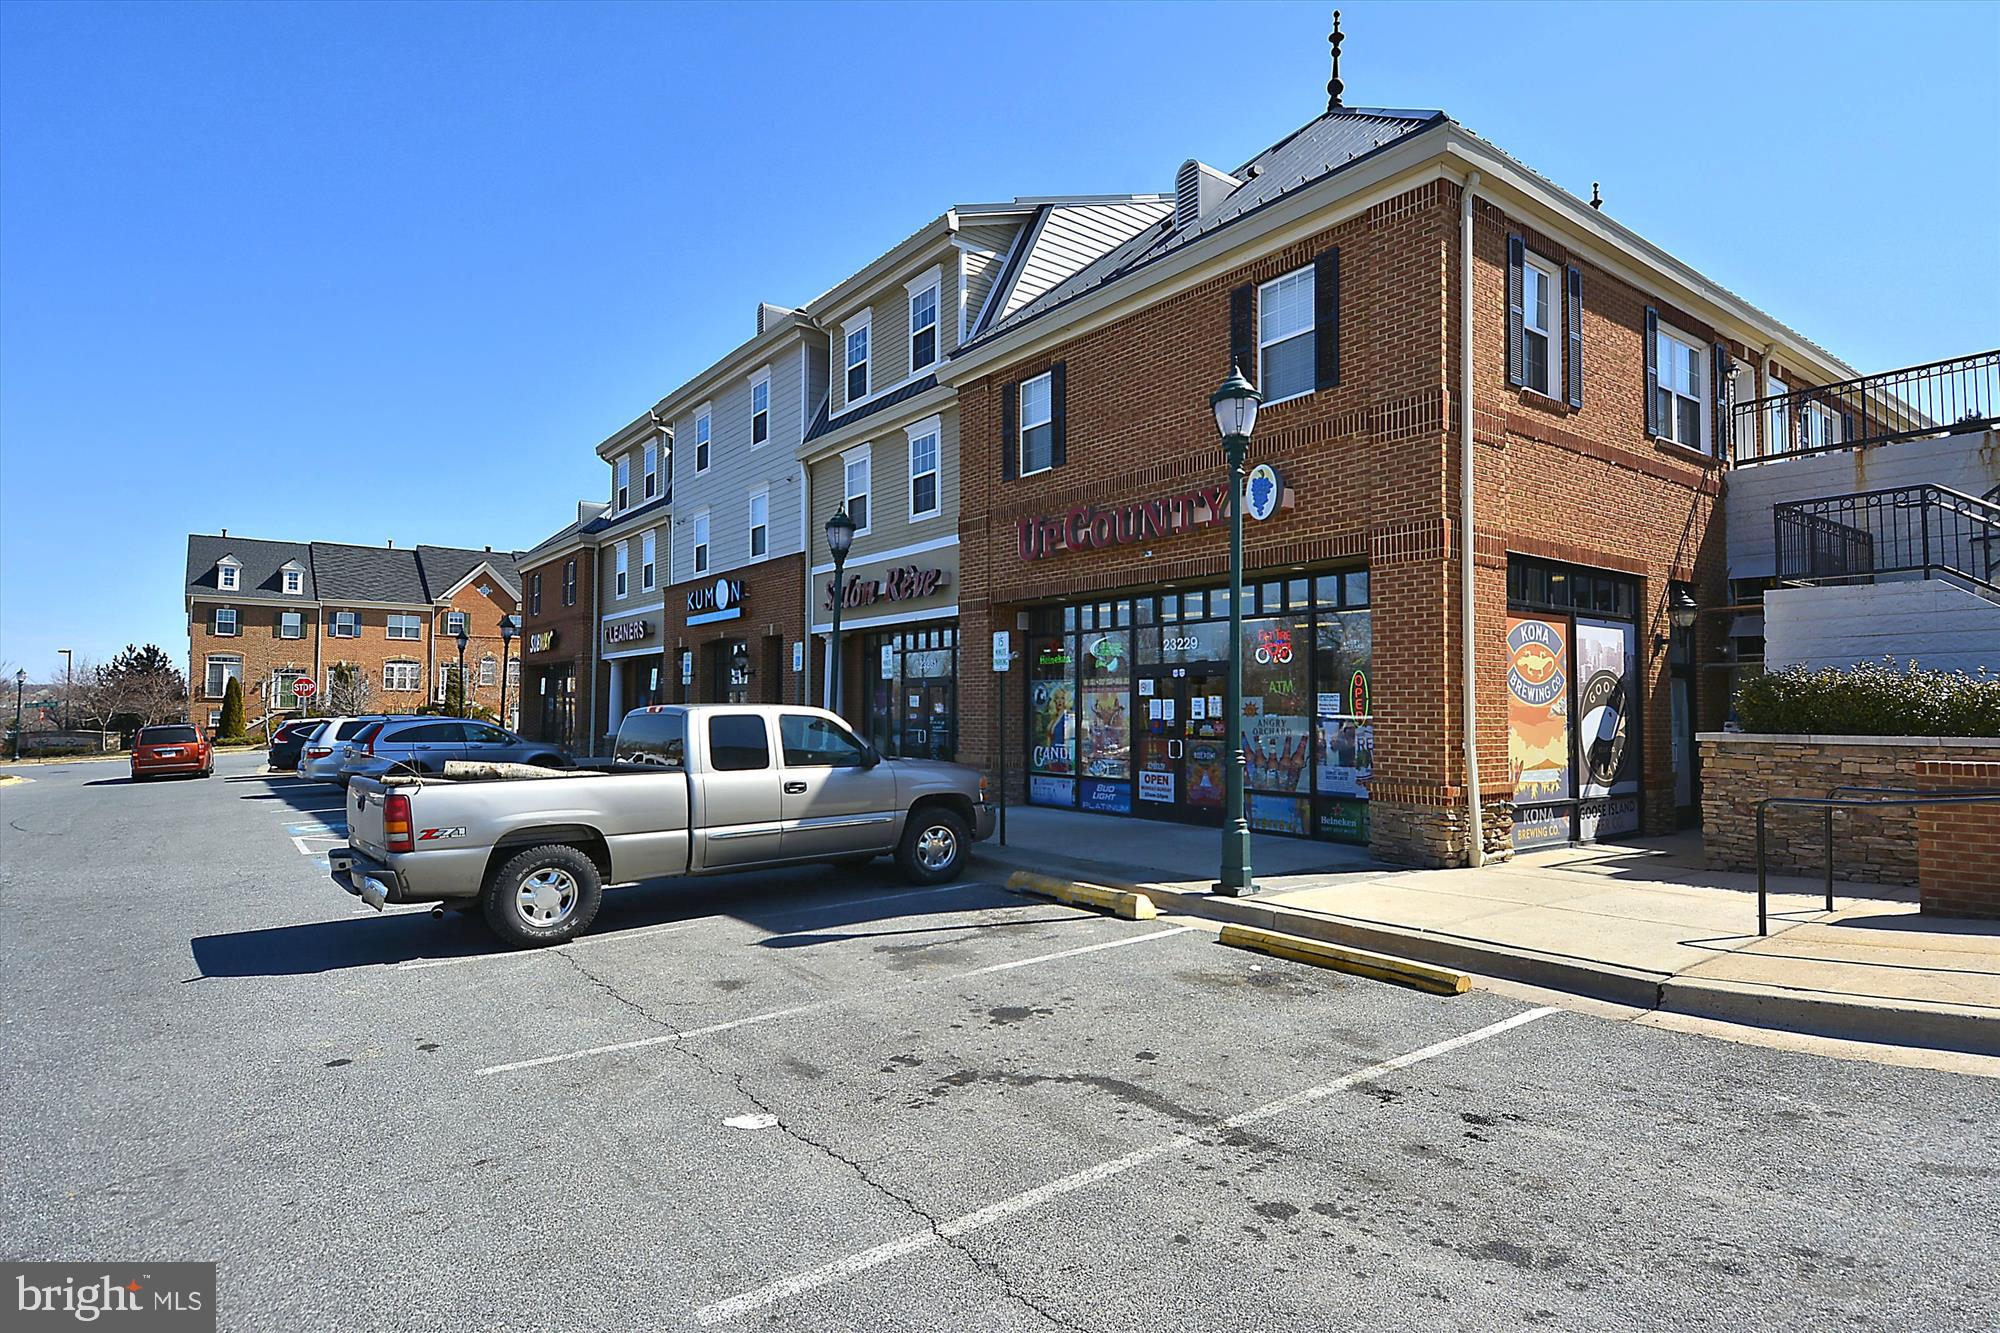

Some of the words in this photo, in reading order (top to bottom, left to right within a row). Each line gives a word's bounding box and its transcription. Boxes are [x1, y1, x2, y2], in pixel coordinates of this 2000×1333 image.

[687, 578, 740, 611] KUMON
[823, 574, 876, 611] Slon
[883, 564, 937, 603] Rêve
[1520, 624, 1549, 645] KONA
[1163, 636, 1198, 651] 23229
[294, 683, 315, 692] STOP
[1269, 680, 1294, 695] ATM
[1509, 672, 1551, 702] BREWING
[1354, 674, 1364, 722] OPEN
[1257, 719, 1287, 728] ANGRY
[1252, 727, 1292, 737] ORCHARD
[1144, 774, 1169, 786] OPEN
[1092, 791, 1117, 801] LIGHT
[1096, 784, 1115, 793] BUD
[1082, 801, 1129, 812] PLATINUM
[1580, 804, 1606, 820] GOOSE
[1608, 800, 1635, 815] ISLAND
[1320, 815, 1357, 827] Heineken
[1523, 807, 1555, 825] KONA
[417, 826, 467, 840] Z71
[1517, 826, 1548, 841] BREWING
[1548, 825, 1560, 836] CO.
